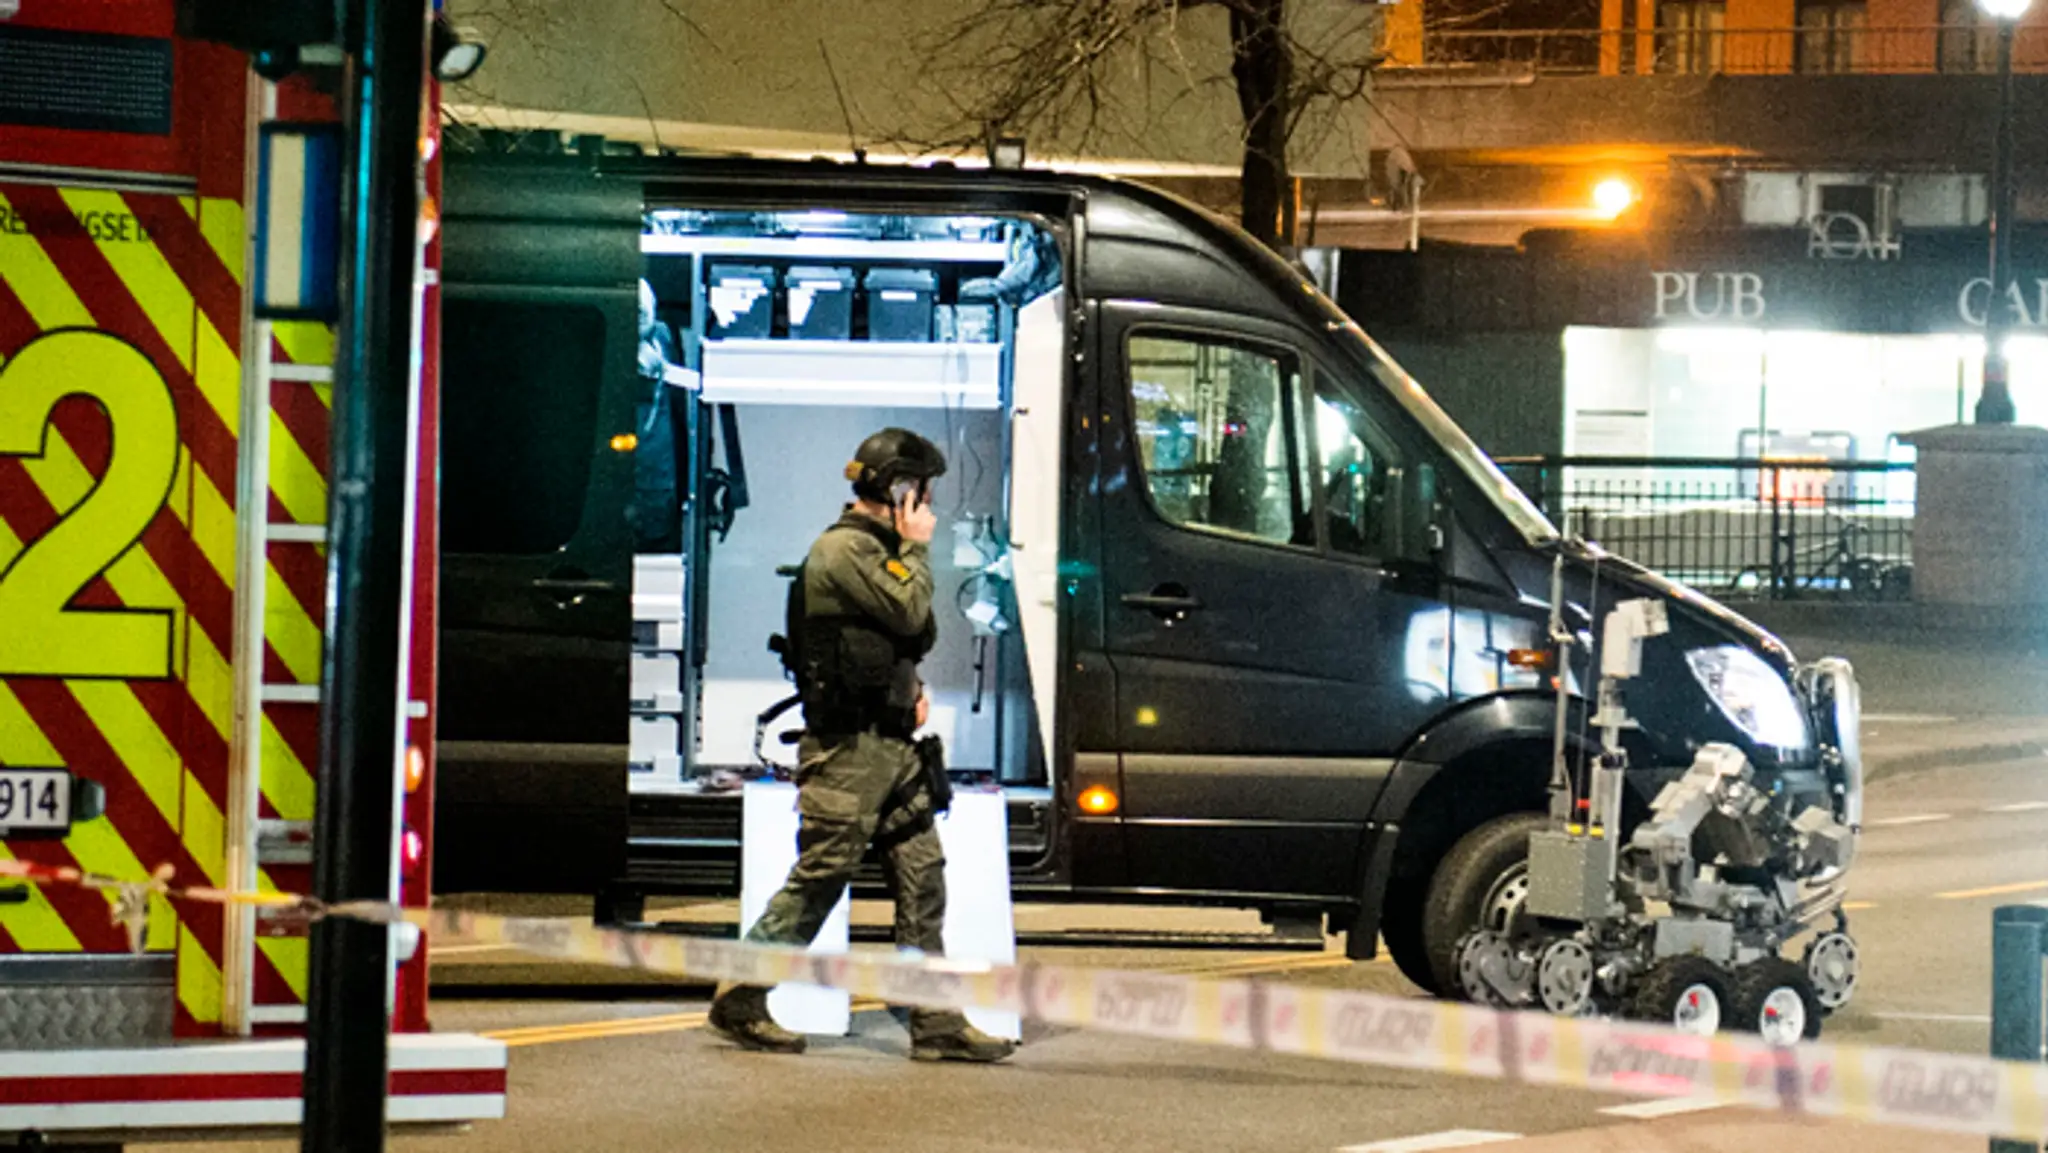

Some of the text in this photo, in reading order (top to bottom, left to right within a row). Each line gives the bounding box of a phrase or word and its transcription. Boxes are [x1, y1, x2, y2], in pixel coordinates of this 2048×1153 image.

[1653, 272, 1765, 320] PUB
[0, 326, 179, 680] 2
[0, 778, 58, 821] 914
